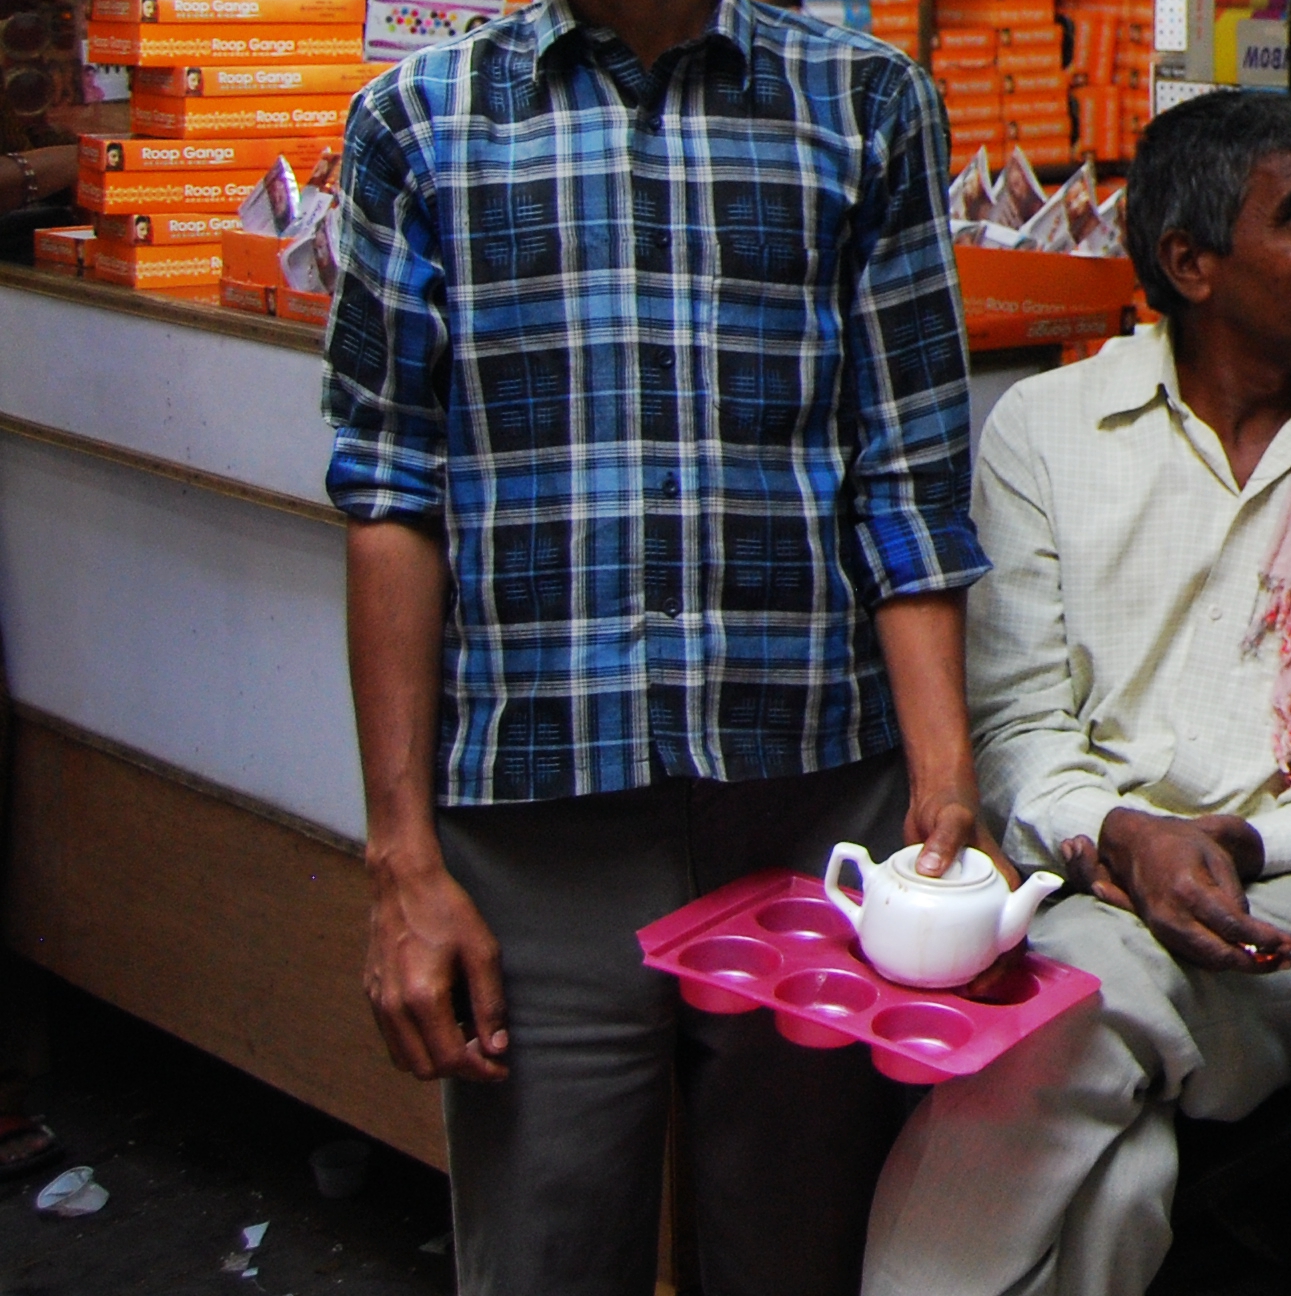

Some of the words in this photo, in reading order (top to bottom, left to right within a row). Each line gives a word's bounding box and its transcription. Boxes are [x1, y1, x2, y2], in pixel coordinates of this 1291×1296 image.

[174, 0, 210, 13] Roop
[213, 0, 259, 14] Ganga
[212, 38, 246, 52] Roop
[249, 38, 295, 54] Ganga
[218, 71, 253, 85] Roop
[256, 71, 302, 86] Ganga
[256, 108, 290, 123] Roop
[293, 108, 337, 123] Ganga
[142, 147, 180, 162] Roop
[183, 146, 235, 162] Ganga
[184, 184, 222, 199] Roop
[225, 184, 253, 197] Gan
[169, 218, 206, 234] Roop
[209, 217, 243, 230] Gan
